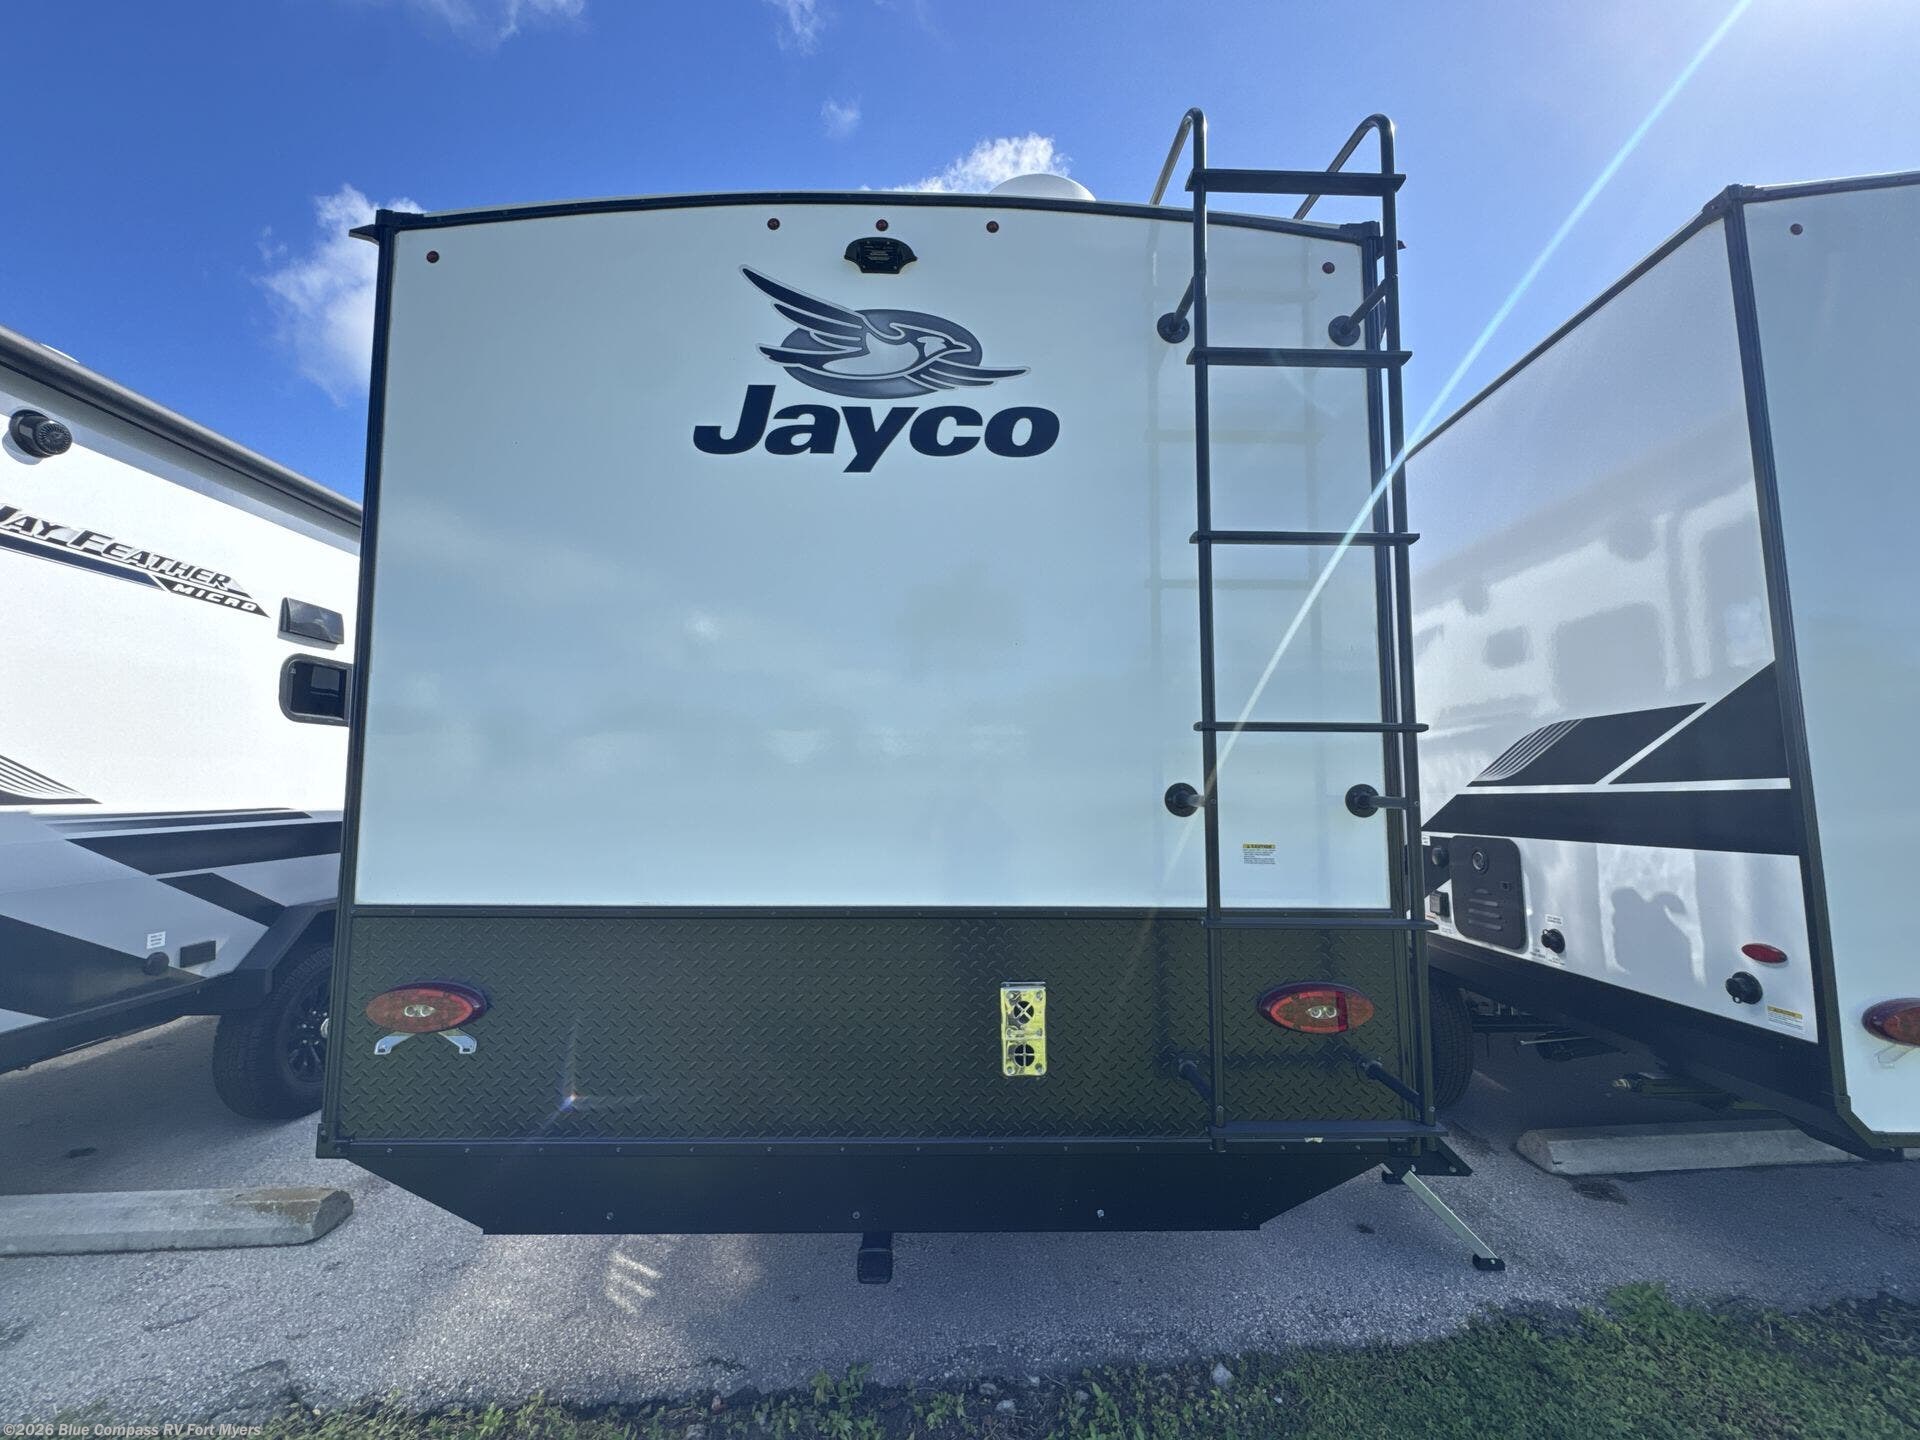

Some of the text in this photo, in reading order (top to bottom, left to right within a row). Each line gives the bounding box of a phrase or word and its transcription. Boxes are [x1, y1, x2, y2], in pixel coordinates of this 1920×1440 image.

[693, 384, 1060, 473] Jayco
[69, 529, 232, 588] FEATHER
[172, 583, 258, 612] MICRO
